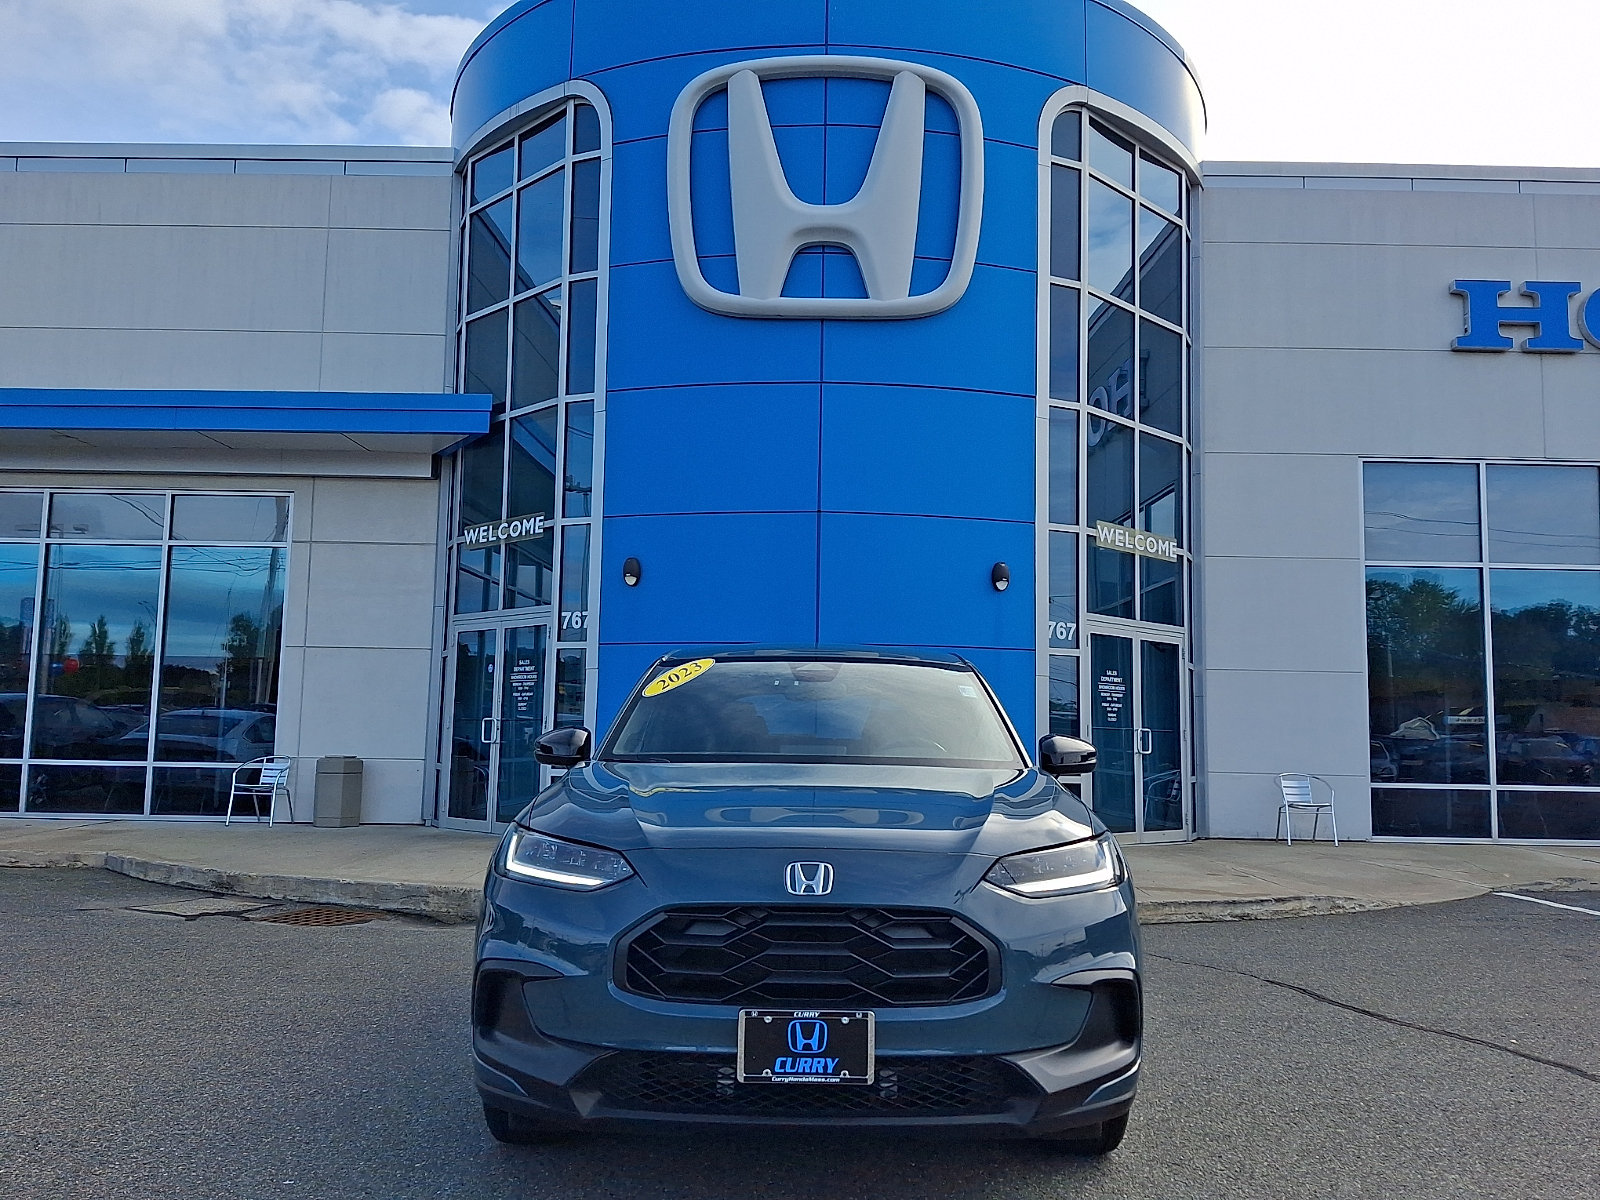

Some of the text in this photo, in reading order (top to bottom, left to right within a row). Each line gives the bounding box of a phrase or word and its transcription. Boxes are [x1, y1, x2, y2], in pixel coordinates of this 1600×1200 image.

[1449, 278, 1600, 353] H
[464, 515, 545, 545] WELCOME
[1097, 524, 1178, 558] WELCOME
[656, 662, 702, 690] 2023
[774, 1057, 839, 1074] CURRY
